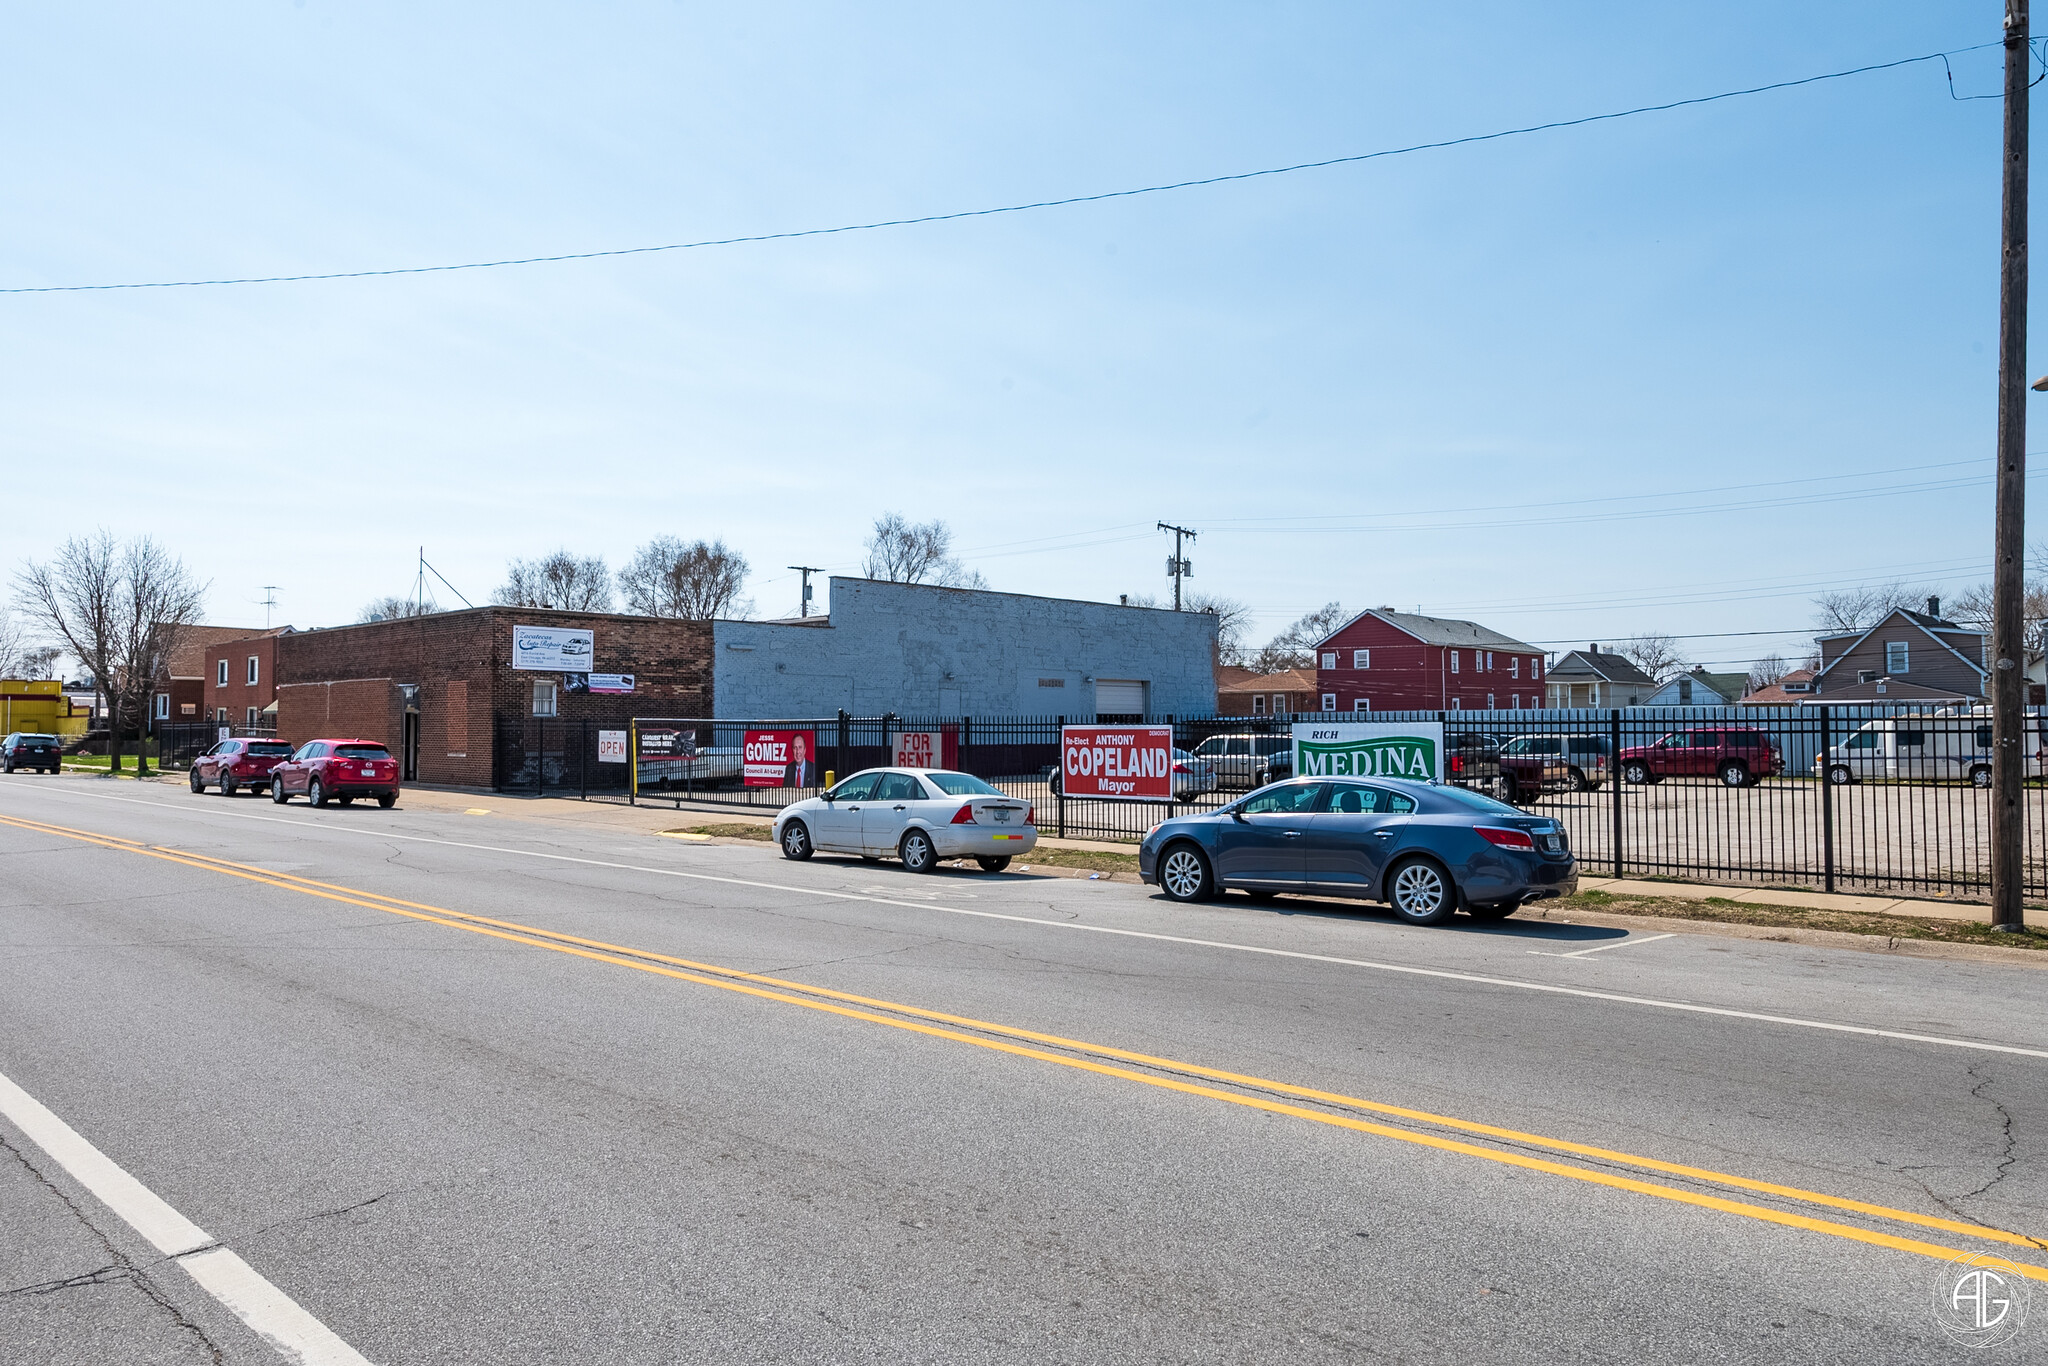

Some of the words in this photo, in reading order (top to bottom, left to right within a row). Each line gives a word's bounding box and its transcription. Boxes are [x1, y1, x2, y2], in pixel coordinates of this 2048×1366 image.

[519, 631, 552, 640] Zacatecas
[540, 640, 561, 649] Repair
[903, 733, 930, 750] FOR
[1065, 736, 1090, 745] Re-Elect
[1095, 734, 1136, 745] ANTHONY
[1311, 730, 1339, 740] RICH
[600, 740, 625, 755] OPEN
[746, 742, 788, 762] GOMEZ
[898, 751, 934, 768] RENT
[1066, 746, 1168, 778] COPELAND
[1302, 746, 1431, 778] MEDINA
[764, 768, 784, 776] At-Large
[1098, 777, 1136, 795] Mayor
